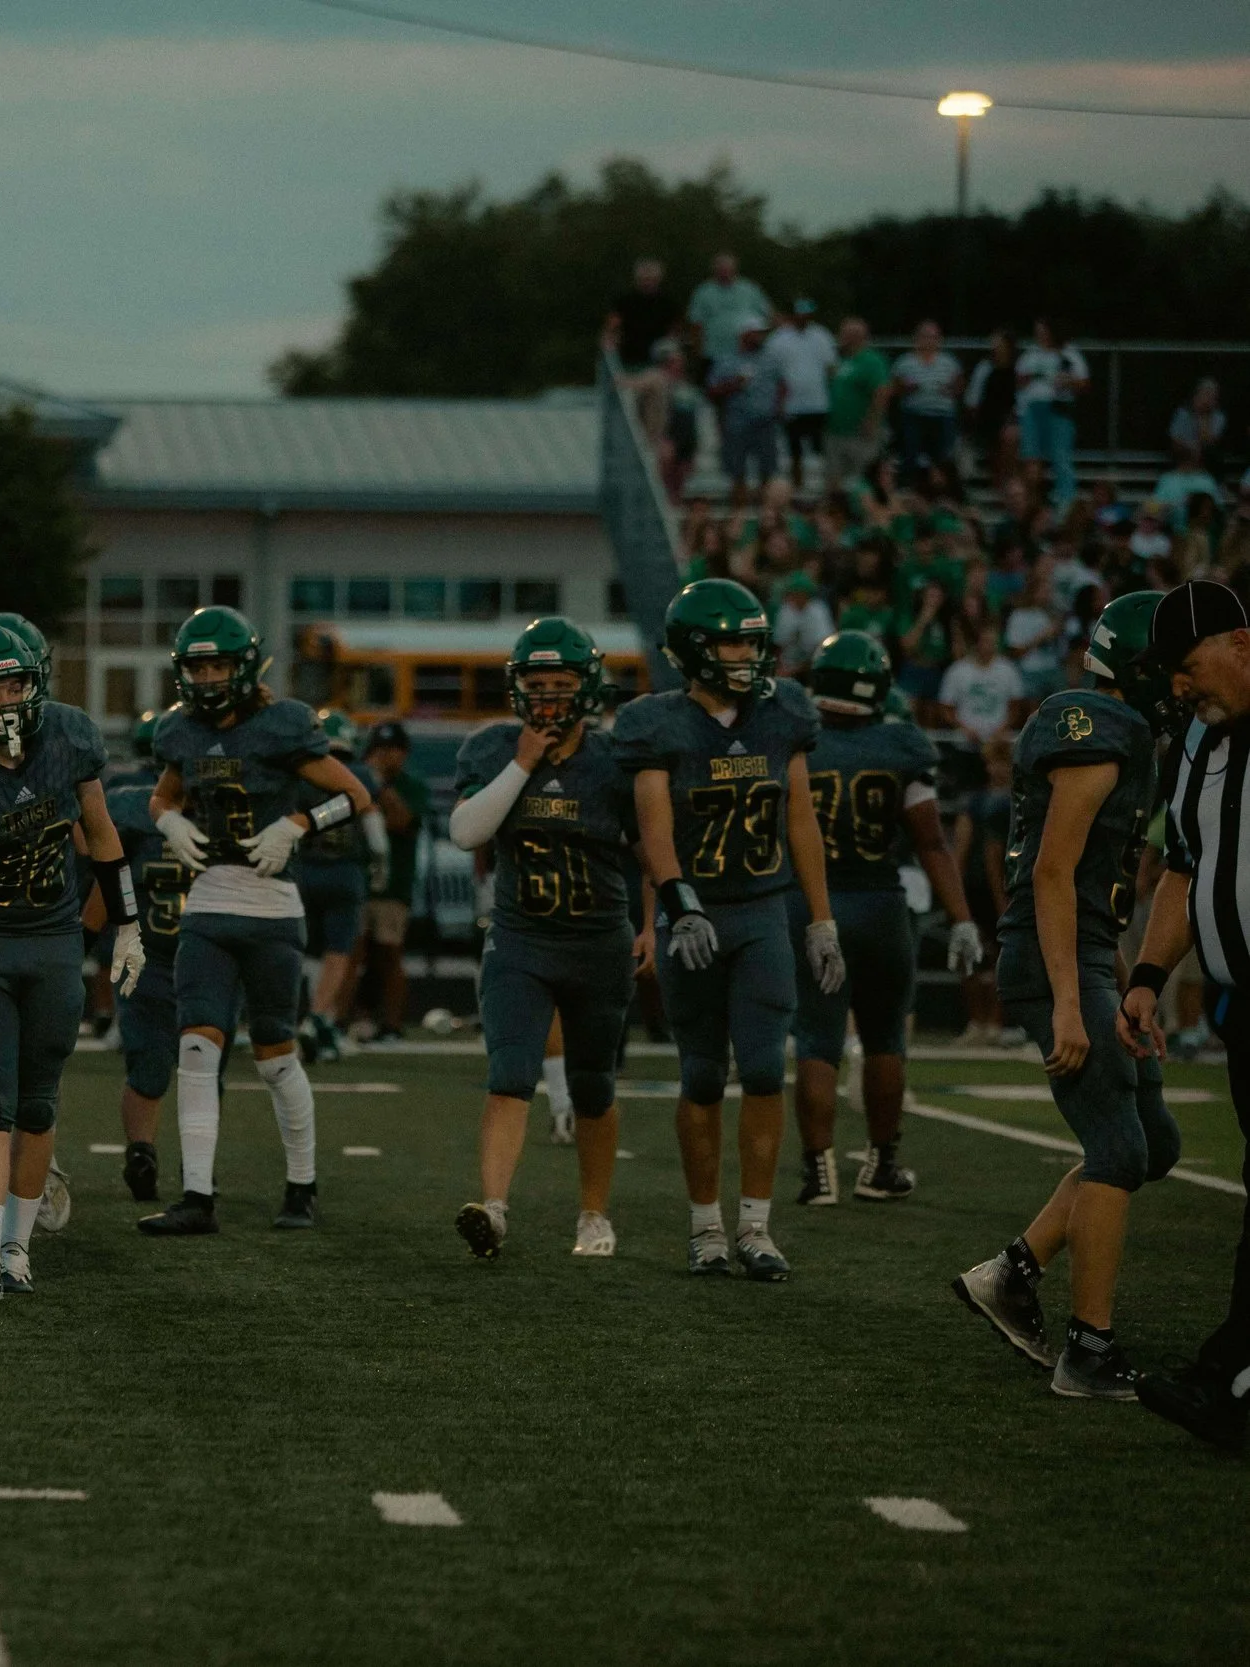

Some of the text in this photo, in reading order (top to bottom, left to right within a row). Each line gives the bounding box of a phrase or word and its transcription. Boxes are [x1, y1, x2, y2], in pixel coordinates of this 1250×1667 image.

[710, 755, 768, 780] IRISH
[2, 798, 57, 836] IRISH
[519, 796, 580, 822] IRISH
[688, 780, 783, 877] 79
